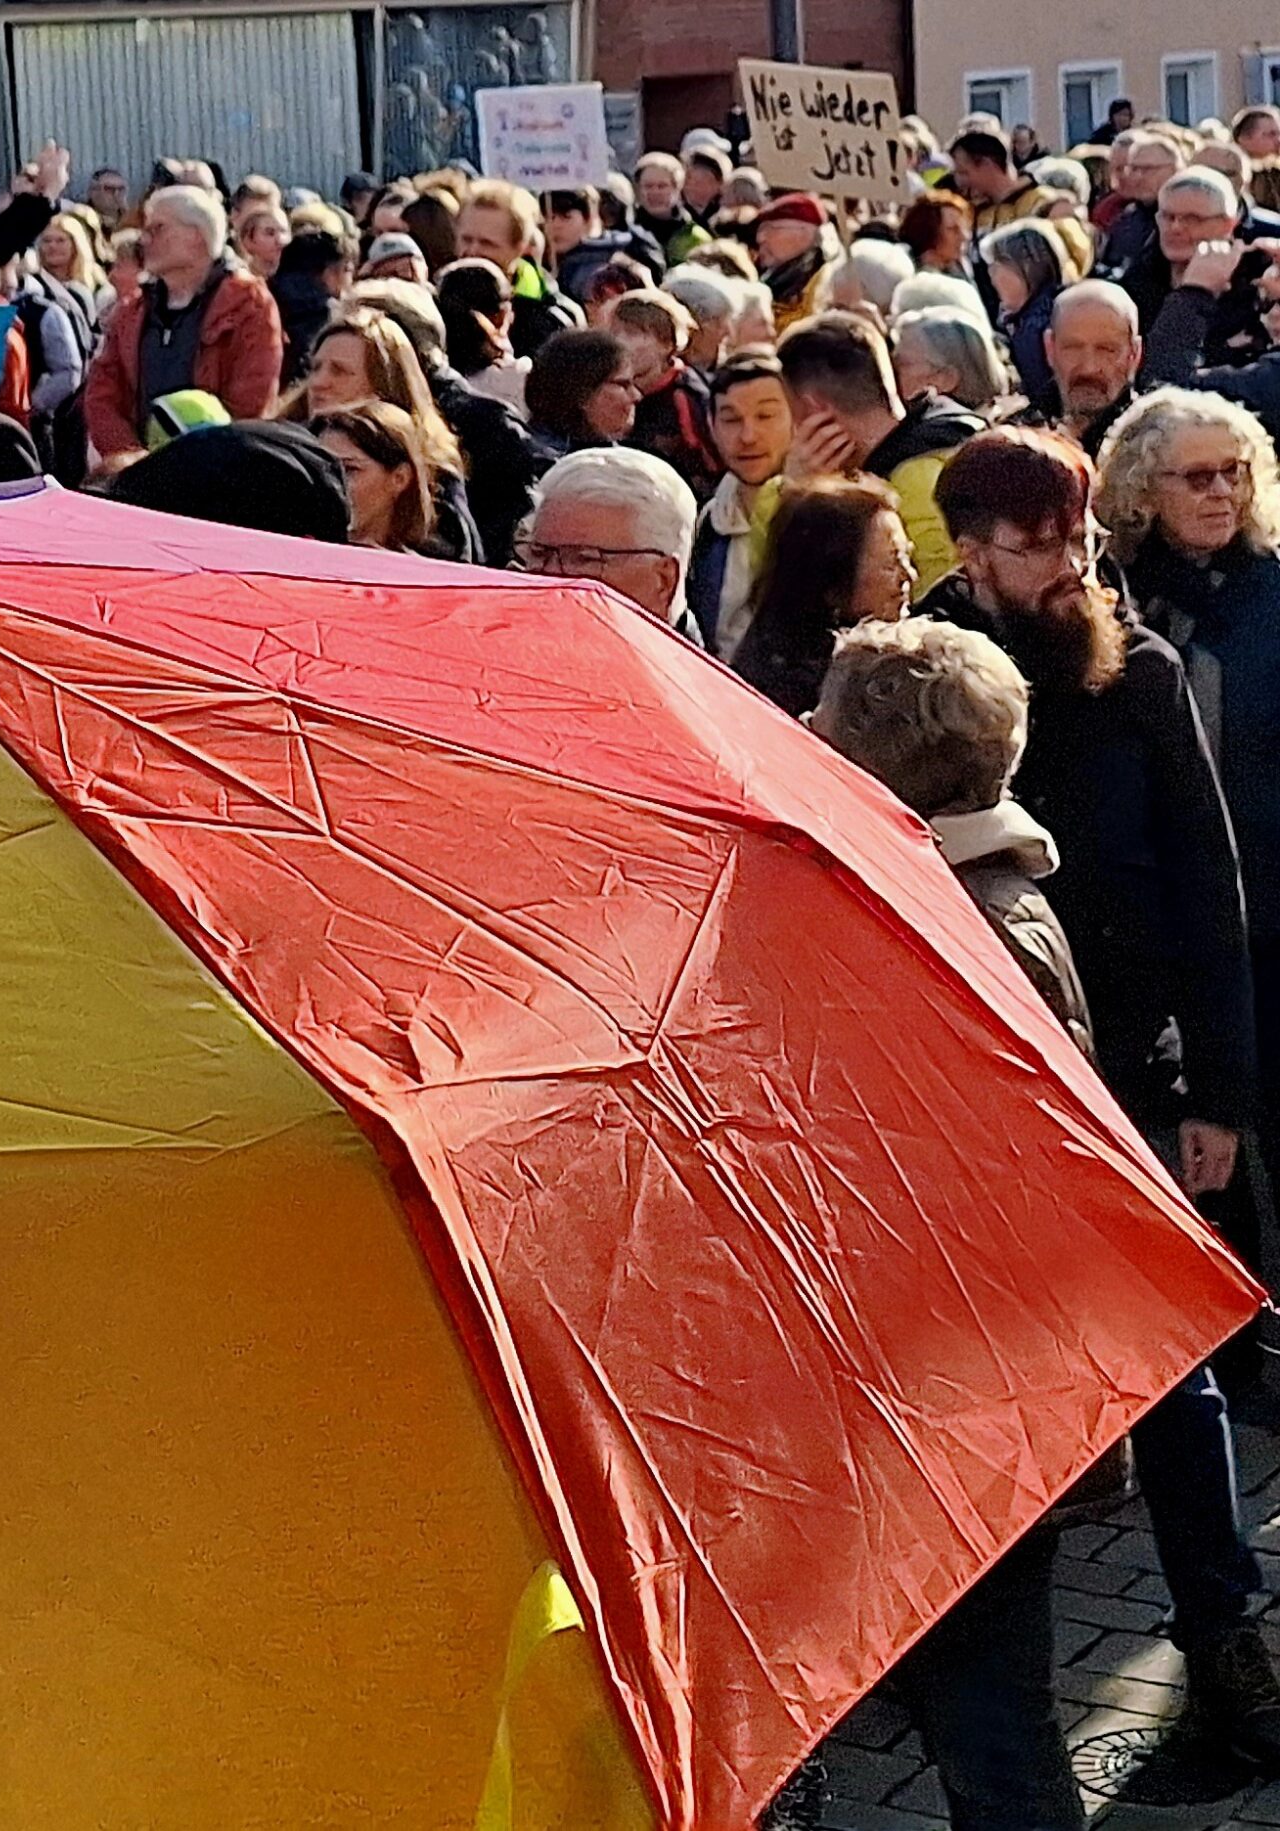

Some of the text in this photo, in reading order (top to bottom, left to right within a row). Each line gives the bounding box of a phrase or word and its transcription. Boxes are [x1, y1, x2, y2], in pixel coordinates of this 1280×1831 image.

[749, 73, 890, 130] Nie wieder
[771, 124, 797, 151] ist
